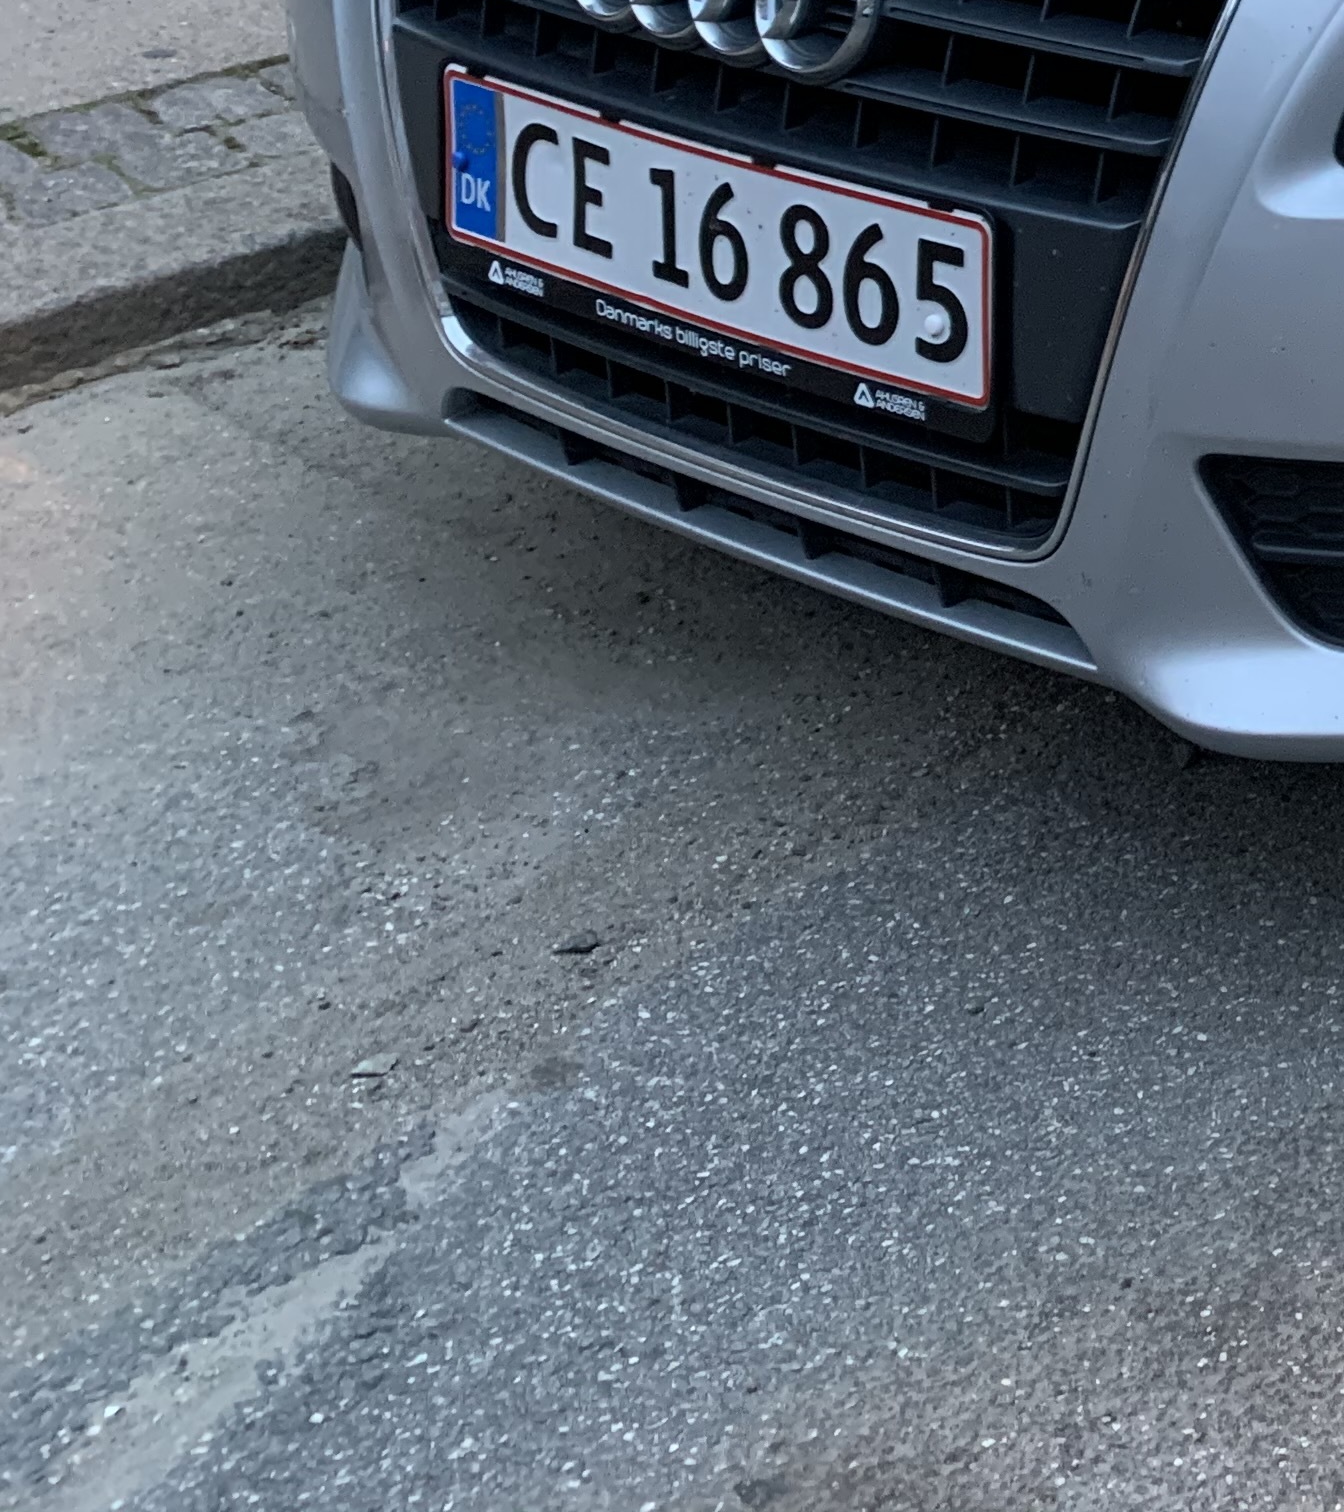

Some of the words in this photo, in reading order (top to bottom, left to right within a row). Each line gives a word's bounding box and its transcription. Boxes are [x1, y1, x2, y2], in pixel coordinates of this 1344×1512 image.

[461, 172, 492, 212] DK
[511, 122, 614, 260] CE
[649, 167, 750, 303] 16
[778, 203, 969, 364] 865
[595, 298, 673, 340] Danmarks
[675, 326, 736, 361] billigste
[739, 350, 792, 378] priser
